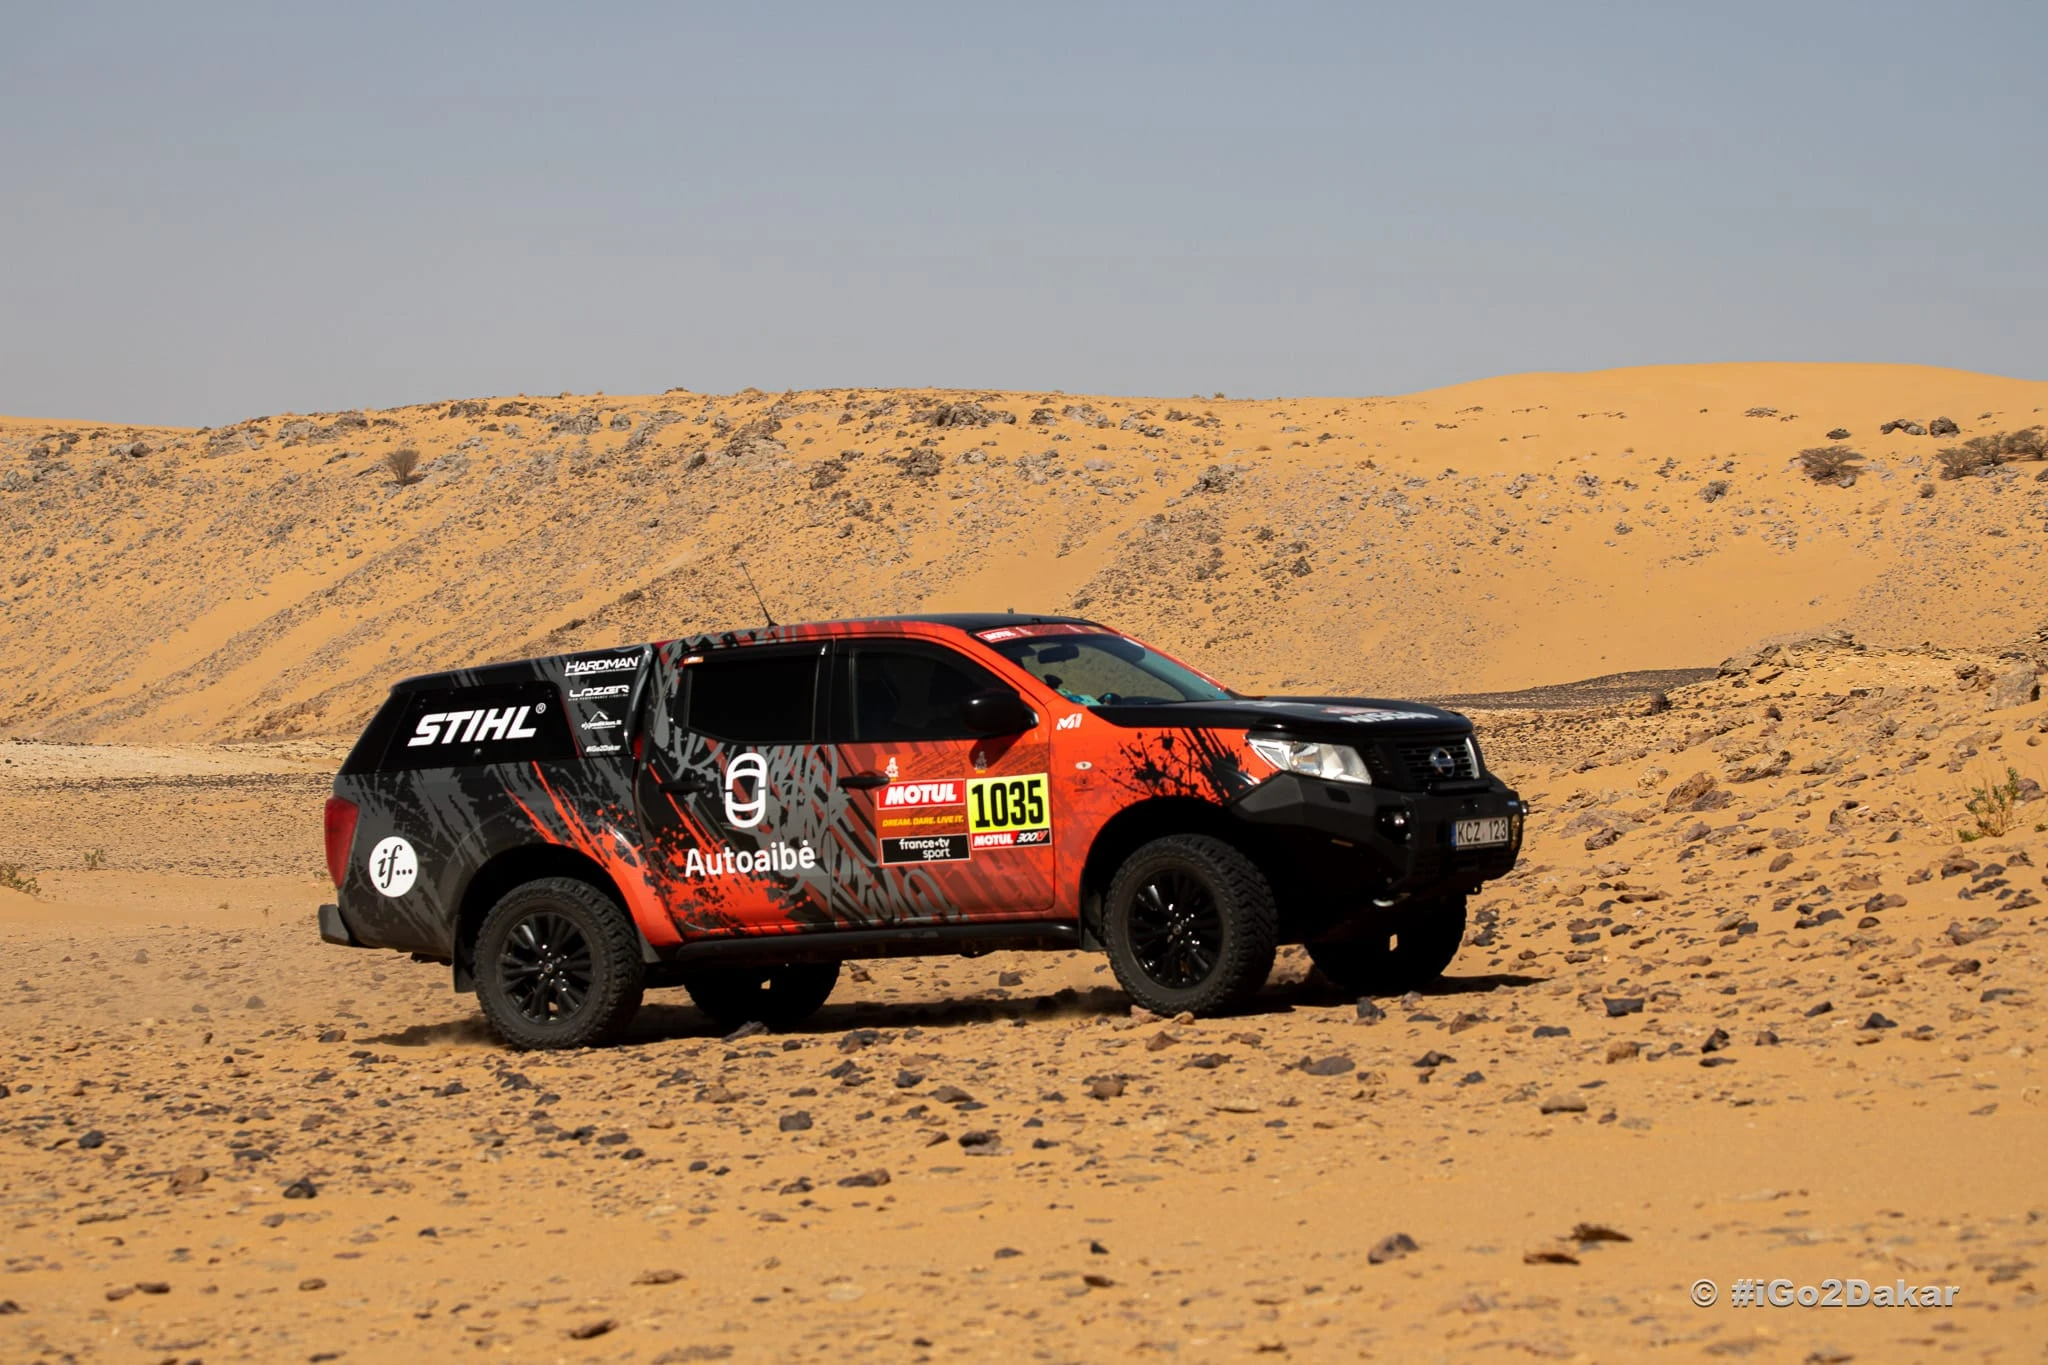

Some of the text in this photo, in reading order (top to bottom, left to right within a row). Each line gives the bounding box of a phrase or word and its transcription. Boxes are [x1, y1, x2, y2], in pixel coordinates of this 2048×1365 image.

[565, 656, 639, 673] HARDMAN
[885, 783, 957, 806] MOTUL
[971, 779, 1045, 828] 1035
[973, 830, 1049, 847] MOTUL 300V
[1457, 819, 1507, 843] KCZ 123
[685, 840, 816, 878] Autoaibė
[922, 848, 951, 861] sport
